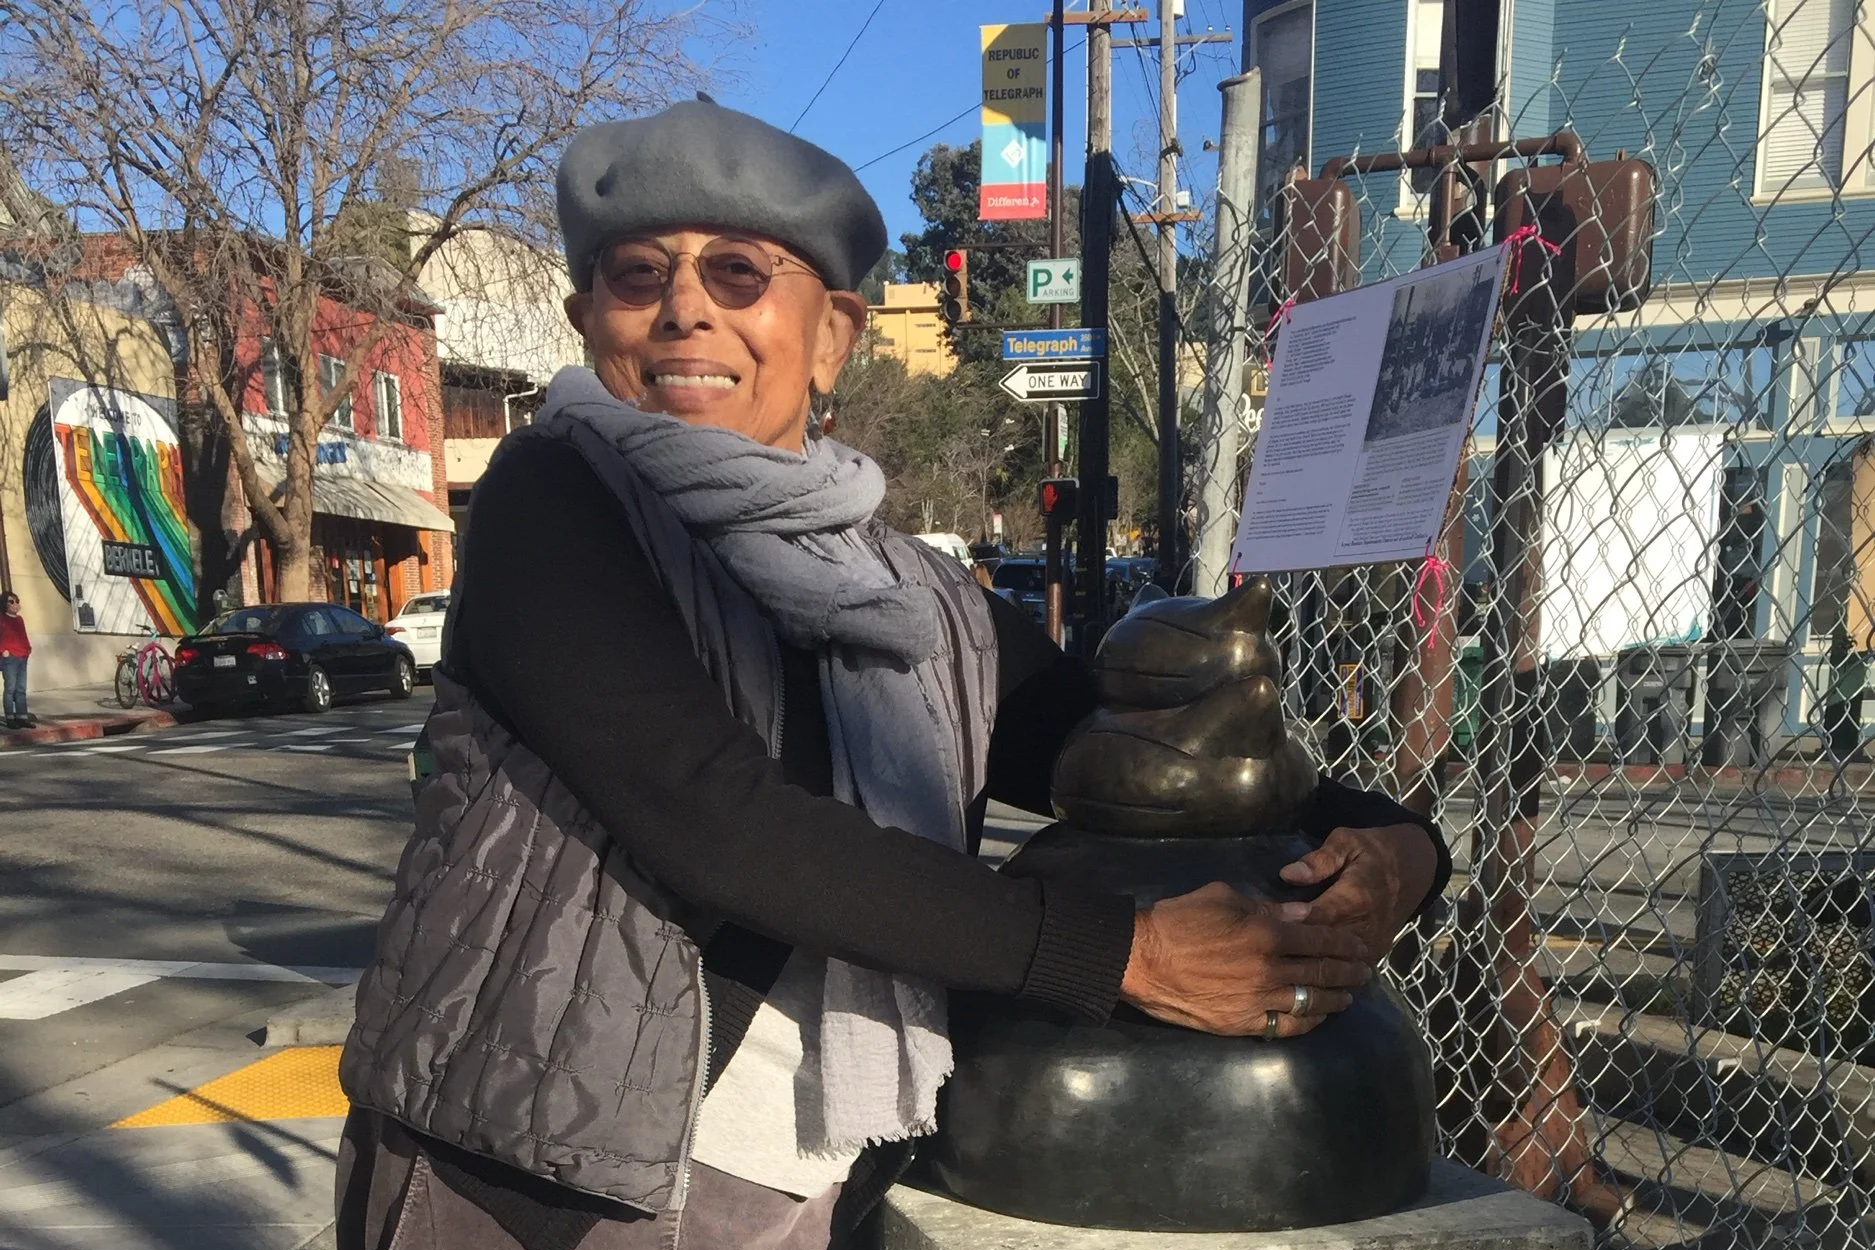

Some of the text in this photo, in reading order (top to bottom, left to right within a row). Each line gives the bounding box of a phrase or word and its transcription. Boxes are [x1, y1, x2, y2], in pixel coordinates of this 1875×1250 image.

[988, 48, 1040, 62] REPUBLIC
[1006, 68, 1021, 80] OF
[984, 87, 1043, 101] TELEGRAPH
[1007, 336, 1078, 356] Telegraph
[1028, 373, 1088, 389] ONE WAY
[132, 411, 142, 426] TO
